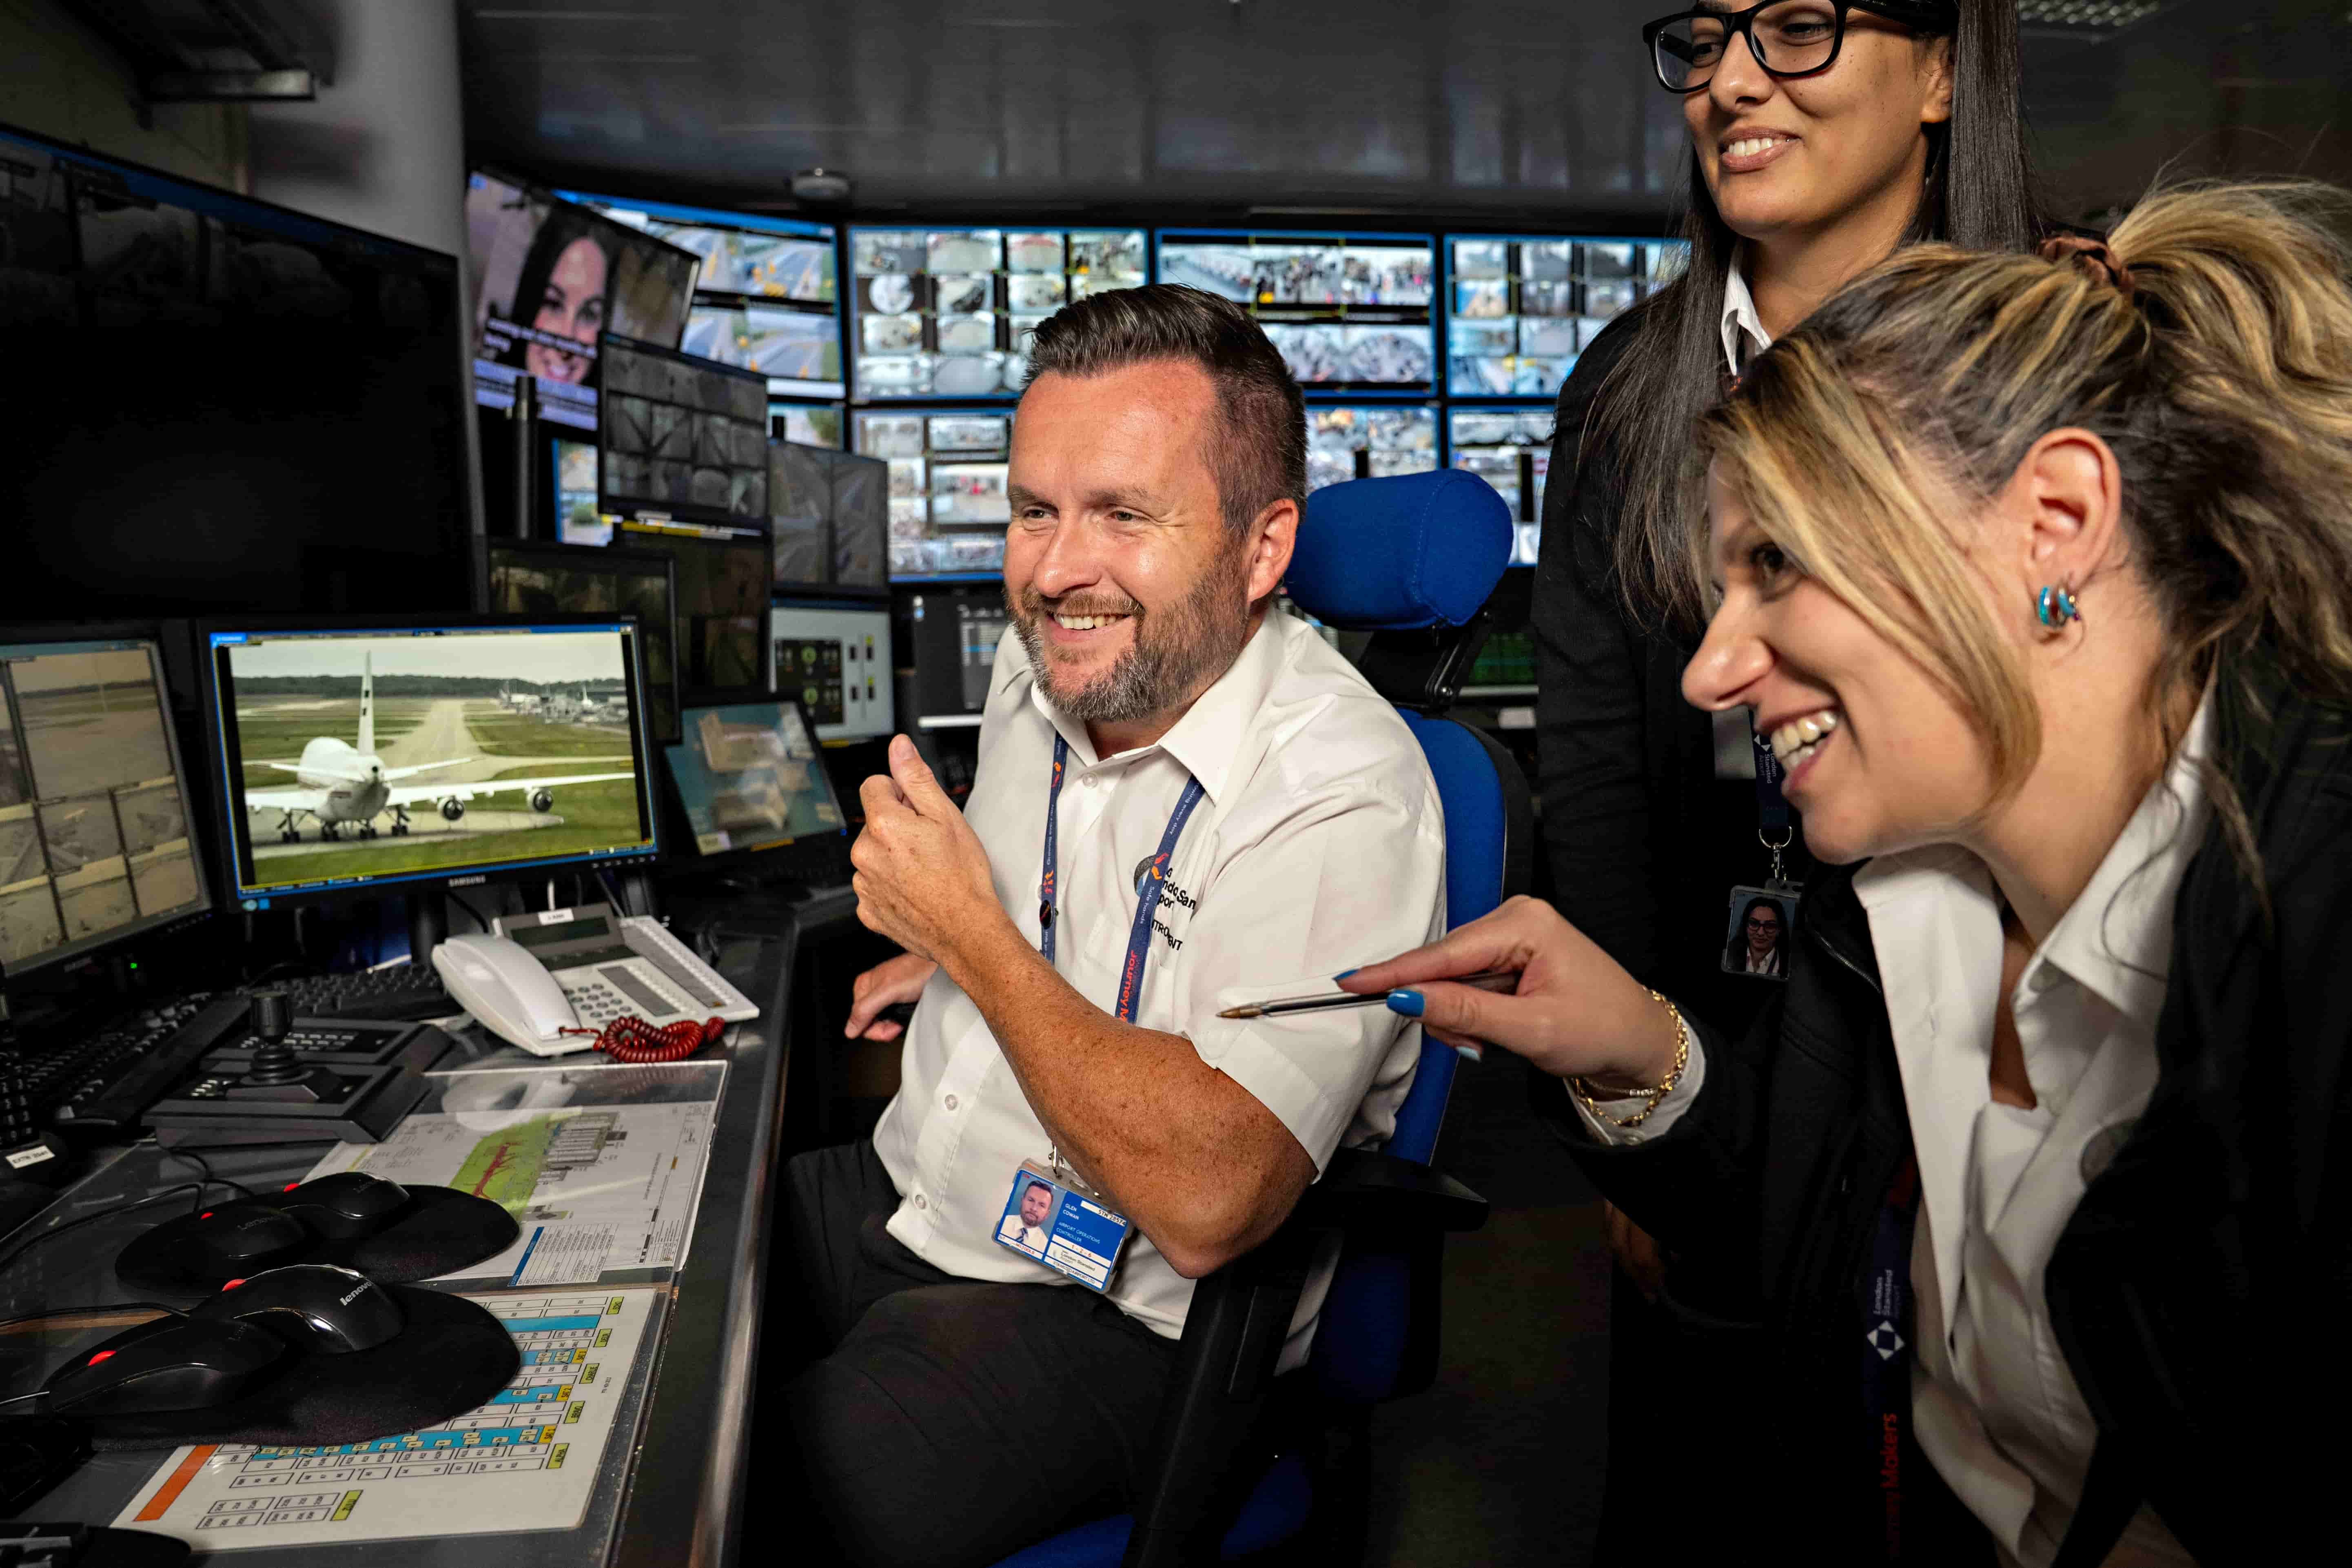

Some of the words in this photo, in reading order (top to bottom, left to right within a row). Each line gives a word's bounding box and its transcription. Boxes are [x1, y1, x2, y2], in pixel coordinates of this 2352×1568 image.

[1145, 886, 1155, 900] Safe
[1120, 950, 1138, 1008] Journey
[1062, 1209, 1080, 1220] COWAN
[339, 1282, 372, 1306] lenovo
[600, 1333, 610, 1343] DELTA
[585, 1366, 597, 1380] CHARLIE
[571, 1406, 582, 1418] BRAVO
[554, 1448, 566, 1463] ALPHA
[1880, 1412, 1900, 1489] Makers
